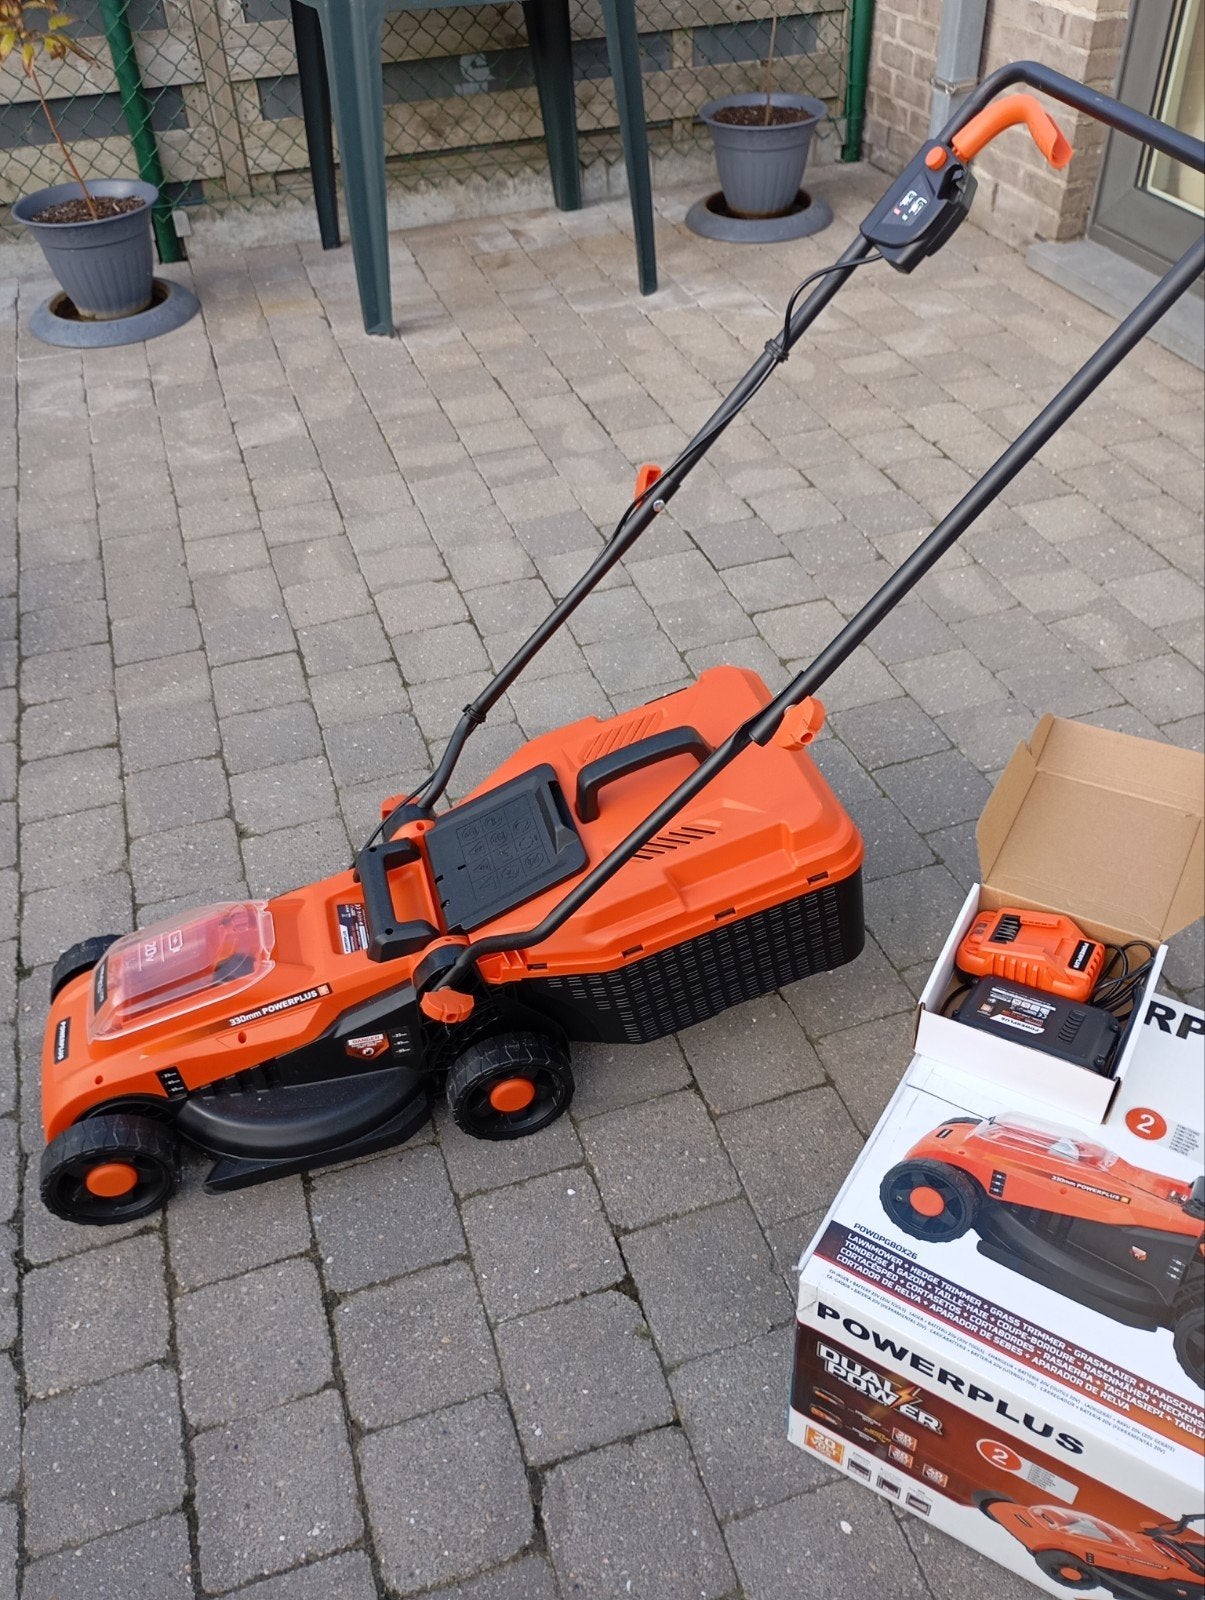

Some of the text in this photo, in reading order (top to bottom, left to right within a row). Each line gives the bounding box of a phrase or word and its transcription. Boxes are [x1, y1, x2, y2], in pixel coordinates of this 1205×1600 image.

[229, 990, 318, 1026] 330mm POWERPLUS
[1137, 1114, 1155, 1134] 2
[1076, 1183, 1120, 1200] POWERPLUS
[854, 1222, 918, 1260] POWDPGBOX26
[836, 1254, 1129, 1411] CORTADOR DE RELVA APARADOR DE SEBES APARADOR DE RELVA
[840, 1247, 898, 1281] CORTACÉSPED
[906, 1281, 962, 1315] CORTASETOS
[970, 1315, 1035, 1352] CORTABORDES
[1043, 1352, 1093, 1383] RASAERBA
[1103, 1382, 1164, 1419] TAGLIASIEPI
[845, 1240, 889, 1267] TONDEUSE
[897, 1267, 926, 1287] GAZON
[934, 1286, 989, 1320] TAILLE-HAIE
[997, 1320, 1076, 1364] COUPE-BORDURE
[1084, 1363, 1150, 1401] RASENMÄHER
[848, 1233, 903, 1266] LAWNMOWER
[910, 1265, 940, 1285] HEDGE
[941, 1280, 982, 1308] TRIMMER
[990, 1306, 1021, 1327] GRASS
[1022, 1322, 1066, 1350] TRIMMER
[1074, 1350, 1137, 1386] GRASMAAIER
[817, 1302, 1084, 1454] POWERPLUS
[819, 1343, 899, 1396] DUAL
[992, 1448, 1010, 1465] 2
